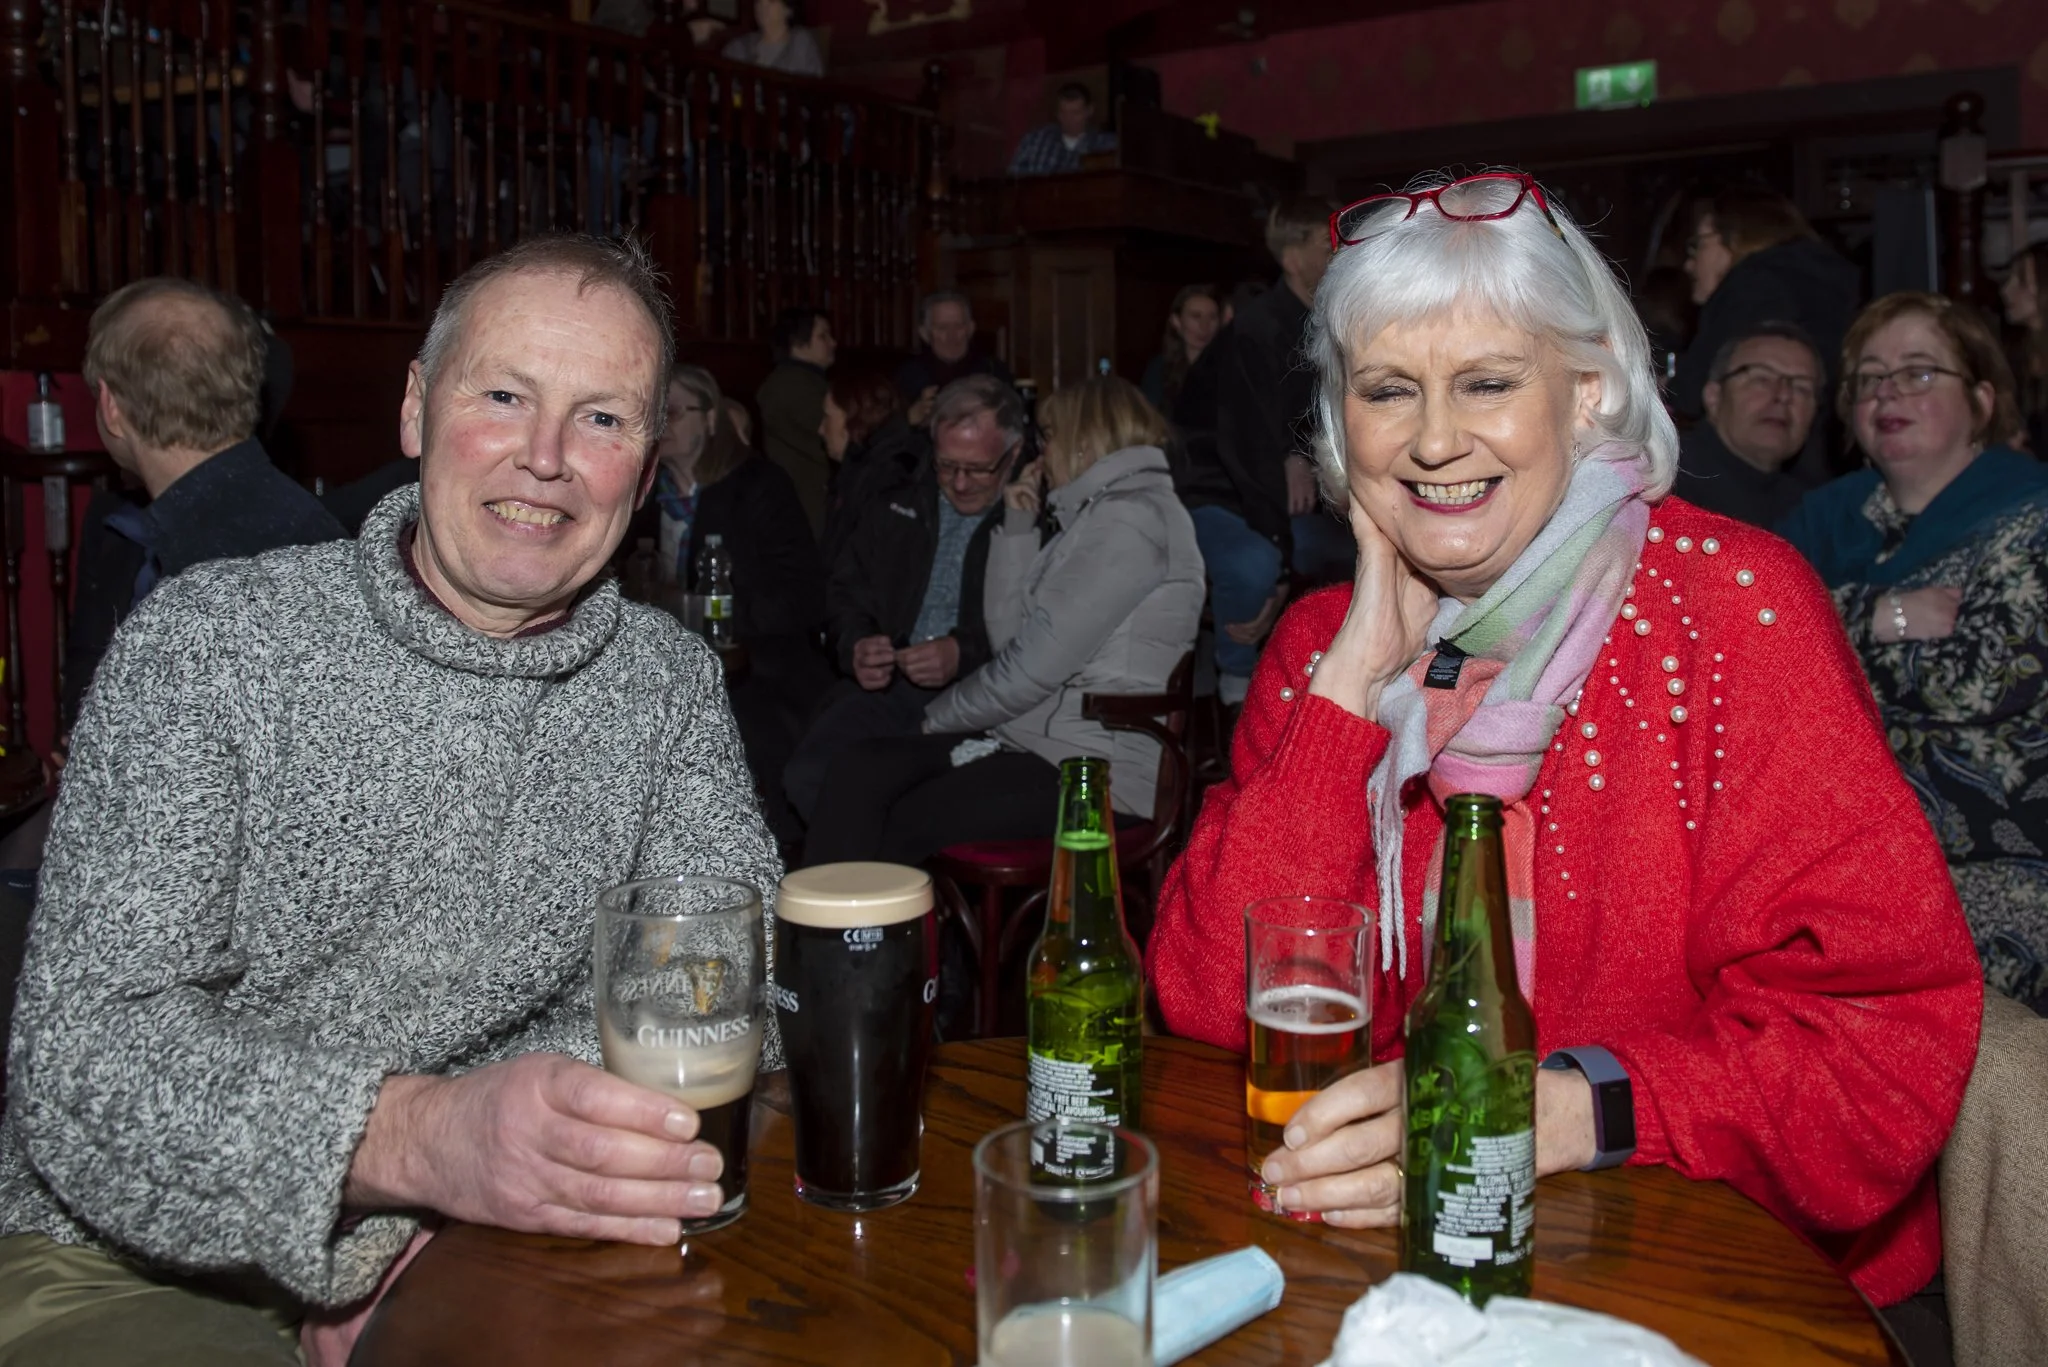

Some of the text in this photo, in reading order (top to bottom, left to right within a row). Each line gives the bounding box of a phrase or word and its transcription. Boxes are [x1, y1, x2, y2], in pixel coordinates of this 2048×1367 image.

[637, 1016, 750, 1048] GUINNESS
[1054, 1092, 1070, 1106] FREE
[1057, 1104, 1105, 1117] FLAVOURINGS
